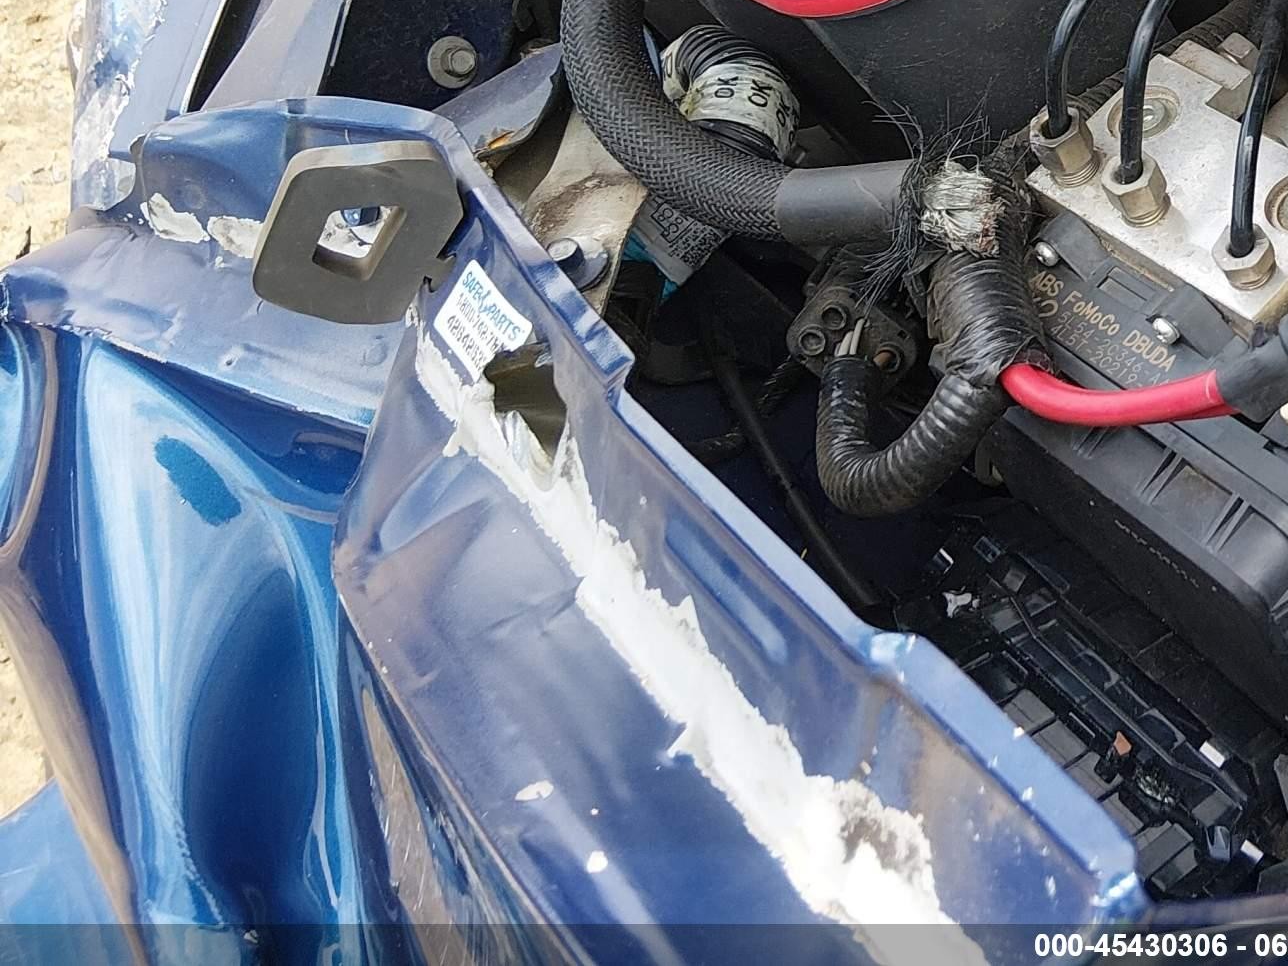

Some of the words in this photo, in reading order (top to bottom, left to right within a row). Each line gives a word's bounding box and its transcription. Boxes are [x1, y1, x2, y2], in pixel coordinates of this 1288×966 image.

[715, 75, 738, 99] OK
[748, 80, 772, 108] OK
[776, 95, 791, 128] OK
[1029, 270, 1064, 297] ABS
[1063, 290, 1121, 336] FoMoCo
[1121, 329, 1177, 373] DBUDA
[1051, 324, 1143, 387] 4L5T-2C219-
